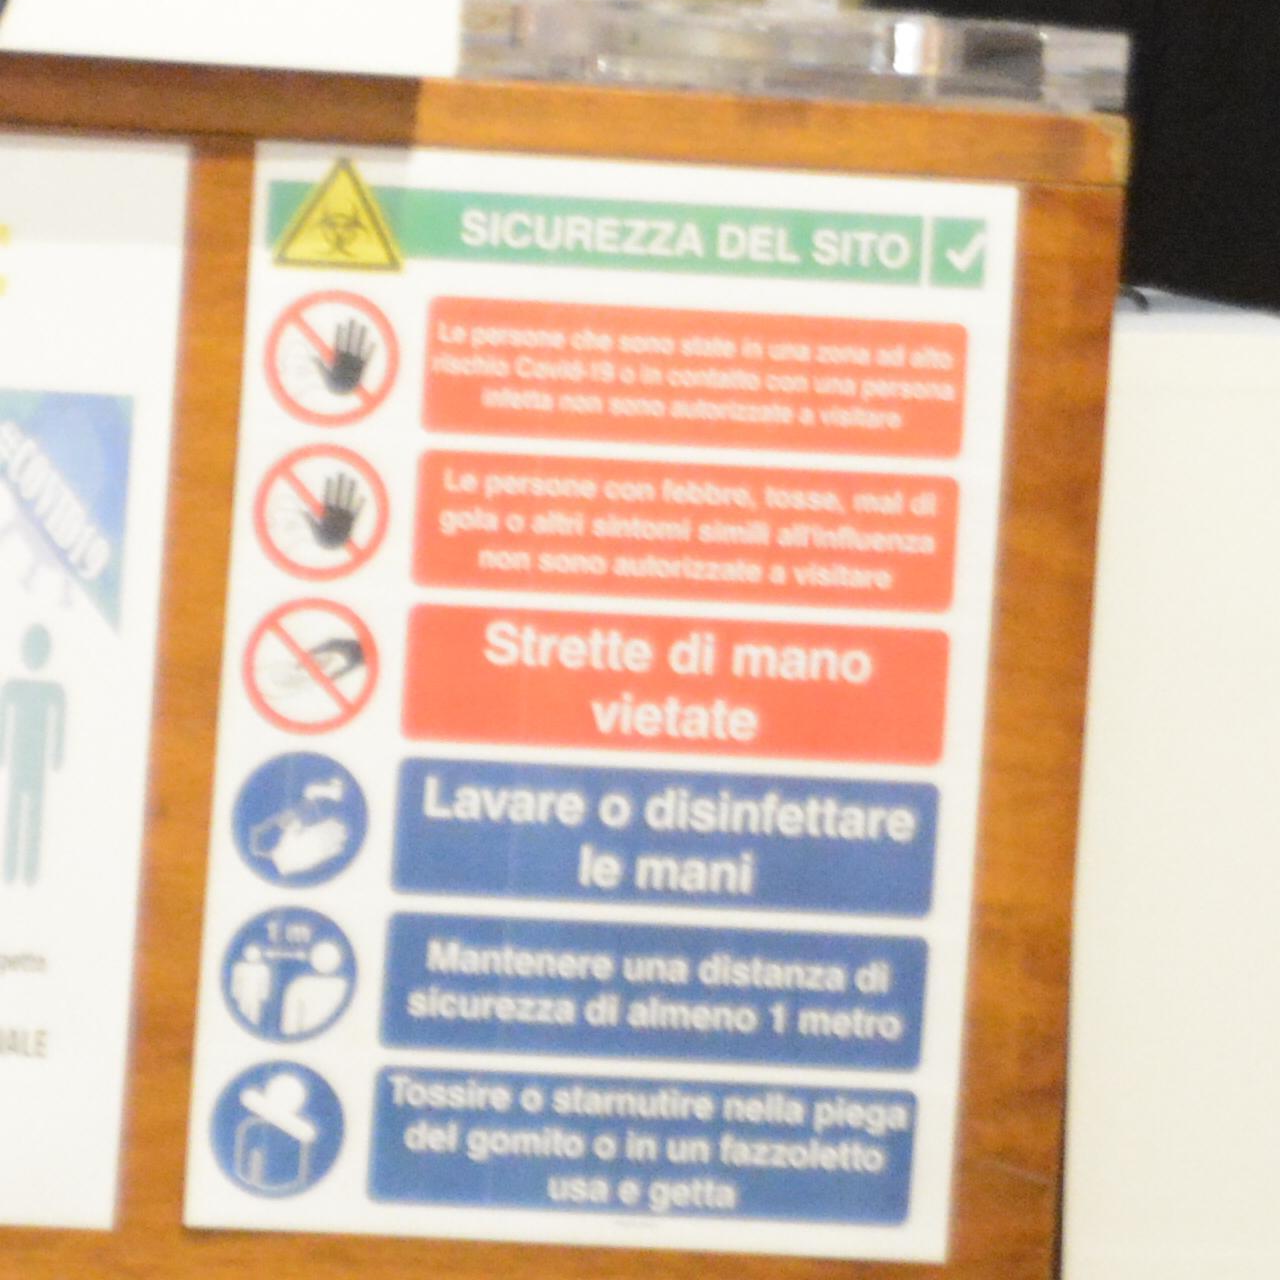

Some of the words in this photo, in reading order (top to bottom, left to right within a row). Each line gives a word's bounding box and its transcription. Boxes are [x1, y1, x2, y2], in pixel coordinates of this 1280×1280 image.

[463, 210, 703, 255] SICUREZZA
[718, 223, 798, 261] DEL
[813, 229, 910, 267] SITO
[444, 469, 478, 491] Le
[483, 474, 598, 498] persone
[602, 480, 655, 500] con
[661, 479, 755, 507] febbre,
[764, 487, 843, 511] tosse,
[854, 491, 904, 513] mal
[910, 492, 936, 515] di
[440, 507, 499, 534] gola
[505, 514, 524, 532] o
[531, 510, 584, 534] altri
[592, 513, 691, 539] sintomi
[699, 521, 770, 543] simili
[777, 524, 934, 553] all'influenza
[479, 550, 530, 569] non
[538, 552, 608, 573] sono
[612, 555, 762, 581] autorizzate
[769, 565, 786, 583] a
[794, 563, 891, 588] visitare
[486, 620, 652, 670] Strette
[669, 633, 715, 673] di
[733, 644, 870, 681] mano
[593, 693, 757, 740] vietate
[424, 775, 586, 825] Lavare
[599, 792, 631, 827] o
[645, 786, 915, 841] disinfettare
[579, 844, 622, 887] le
[636, 853, 753, 892] mani
[427, 939, 613, 979] Mantenere
[624, 957, 688, 982] una
[699, 954, 846, 990] distanza
[855, 961, 888, 991] di
[408, 987, 576, 1023] sicurezza
[585, 994, 619, 1024] di
[627, 996, 756, 1031] almeno
[771, 1004, 786, 1031] 1
[799, 1009, 902, 1038] metro
[390, 1073, 511, 1110] Tossire
[521, 1087, 543, 1111] o
[553, 1085, 714, 1118] starnutire
[724, 1092, 805, 1123] nella
[814, 1097, 908, 1134] piega
[405, 1121, 458, 1150] del
[468, 1127, 584, 1159] gomito
[594, 1135, 616, 1158] o
[626, 1132, 657, 1158] in
[667, 1138, 710, 1161] un
[720, 1134, 884, 1170] fazzoletto
[548, 1179, 608, 1203] usa
[618, 1182, 642, 1205] e
[648, 1181, 738, 1213] getta
